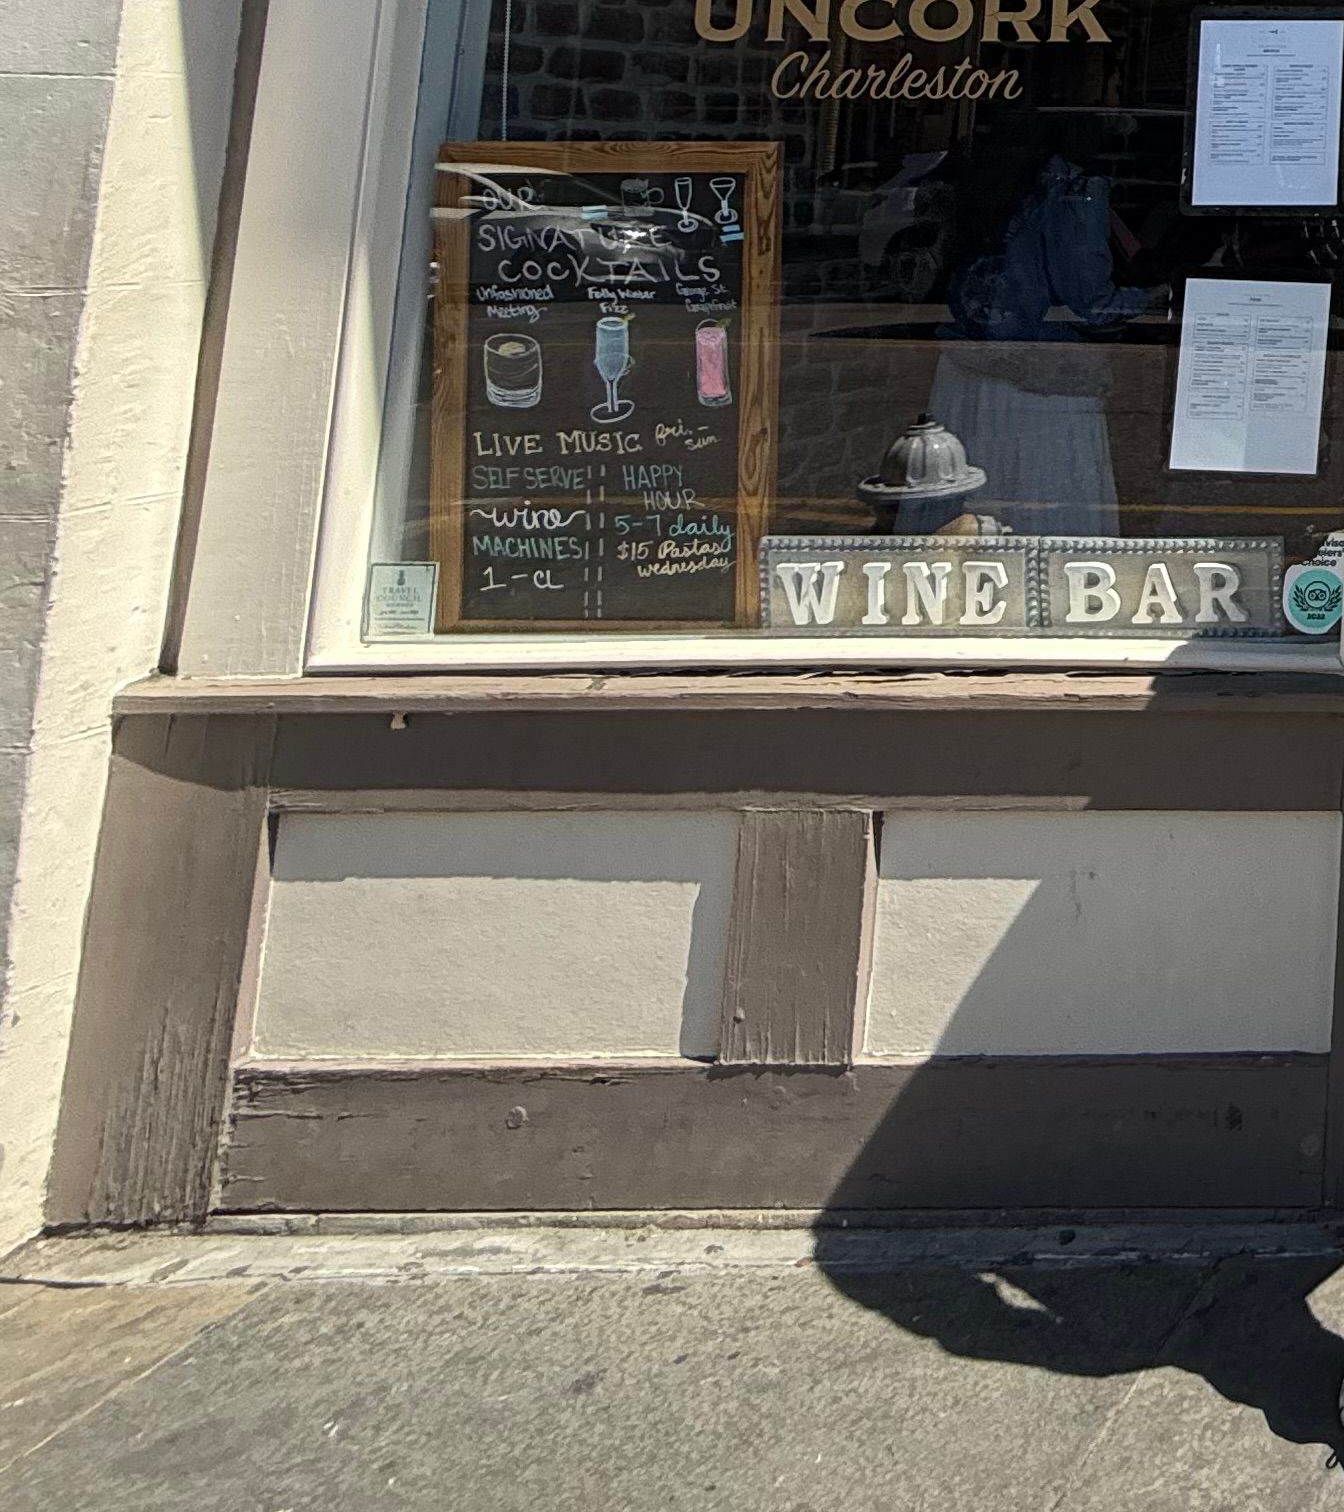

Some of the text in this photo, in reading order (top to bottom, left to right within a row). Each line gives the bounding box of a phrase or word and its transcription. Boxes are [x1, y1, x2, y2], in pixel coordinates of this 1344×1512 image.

[771, 49, 1023, 100] Charleston
[498, 255, 721, 286] COCKTAILS
[472, 431, 543, 456] LIVE
[556, 430, 642, 454] MUSIC
[472, 465, 585, 489] SELF SERVE
[622, 464, 683, 490] HAPPY
[643, 488, 705, 511] HOUR
[474, 500, 584, 529] wine
[669, 513, 735, 551] daily
[472, 535, 583, 559] MACHINES
[616, 540, 653, 561] $15
[776, 561, 1249, 625] WINE BAR
